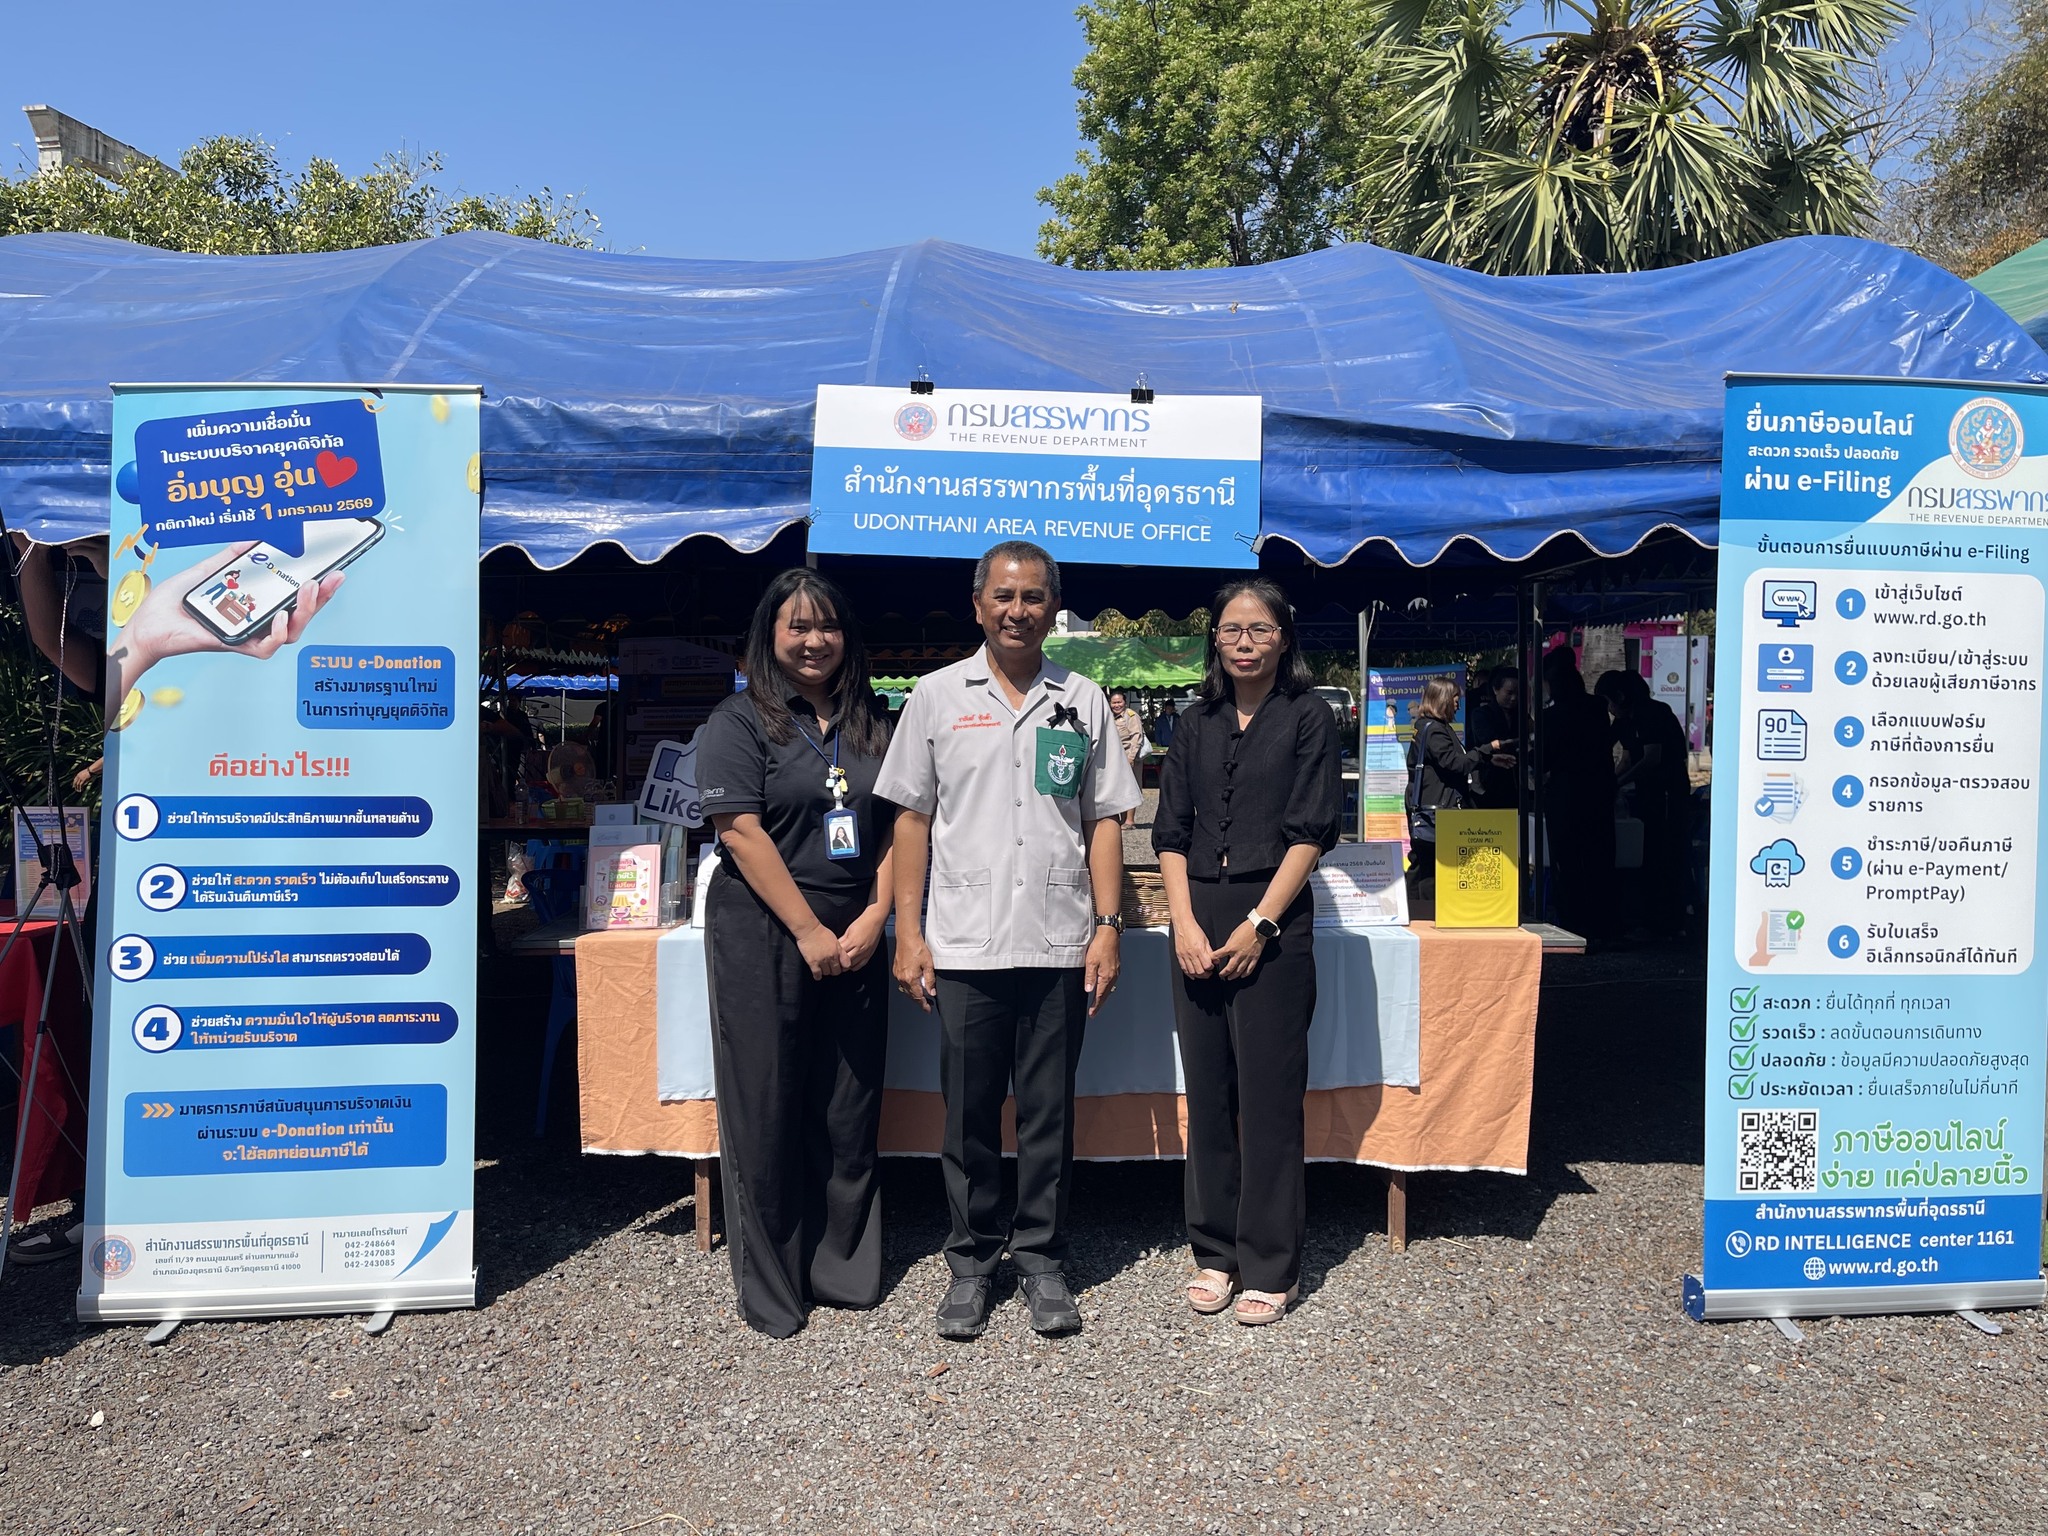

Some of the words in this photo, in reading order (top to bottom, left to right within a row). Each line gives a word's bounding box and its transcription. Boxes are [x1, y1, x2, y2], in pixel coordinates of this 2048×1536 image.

[187, 410, 312, 439] เพิ่มความเชื่อมั่น
[948, 403, 1150, 433] กรมสรรพากร
[1746, 402, 1915, 437] ยื่นภาษีออนไลน์
[161, 434, 344, 465] ในระบบบริจาคยุคดิจิทัล
[950, 432, 978, 443] THE
[982, 433, 1048, 446] REVENUE
[1053, 435, 1148, 448] DEPARTMENT
[1747, 444, 1790, 458] สะดวก
[1793, 443, 1840, 459] รวดเร็ว
[1844, 445, 1900, 461] ปลอดภัย
[167, 470, 265, 505] อิ่มบุญ
[273, 462, 317, 497] อุ่น
[844, 464, 1236, 513] สำนักงานสรรพากรพื้นที่อุดรธานี
[1744, 466, 1790, 491] ผ่าน
[1797, 470, 1892, 498] e-Filing
[1908, 486, 2048, 512] กรมสรรพาก
[155, 511, 215, 533] กติกาใหม่
[218, 508, 257, 526] เริ่มใช้
[261, 503, 273, 520] 1
[277, 504, 333, 519] มกราคม
[337, 497, 373, 512] 2569
[1909, 513, 1931, 523] THE
[1934, 514, 1984, 524] REVENUE
[1987, 515, 2048, 527] DEPARTMEN
[853, 513, 977, 534] UDONTHANI
[984, 517, 1037, 536] AREA
[1044, 520, 1135, 540] REVENUE
[1142, 523, 1212, 542] OFFICE
[1757, 534, 1963, 558] ขั้นตอนการยื่นแบบภาษีผ่าน
[1967, 544, 2030, 564] e-Filing
[1845, 598, 1854, 611] 1
[1874, 584, 1963, 605] เข้าสู่เว็บไซต์
[1874, 610, 1987, 630] www.rd.go.th
[310, 656, 353, 670] ระบบ
[358, 656, 442, 670] e-Donation
[1846, 661, 1857, 675] 2
[1872, 648, 2029, 670] ลงทะเบียน/เข้าสู่ระบบ
[314, 677, 438, 697] สร้างมาตรฐานใหม่
[1872, 673, 2037, 694] ด้วยเลขผู้เสียภาษีอากร
[303, 701, 449, 722] ในการทำบุญยุคดิจิทัล
[1871, 712, 1986, 729] เลือกแบบฟอร์ม
[1764, 717, 1787, 734] 90
[1843, 726, 1854, 739] 3
[1869, 732, 1995, 754] ภาษีที่ต้องการยื่น
[209, 751, 351, 778] ดีอย่างไร!!!
[1841, 784, 1853, 798] 4
[1869, 772, 2031, 793] กรอกข้อมูล-ตรวจสอบ
[643, 784, 702, 821] Like
[1868, 799, 1924, 813] รายการ
[124, 805, 141, 830] 1
[167, 808, 421, 827] ช่วยให้การบริจาคมีประสิทธิภาพมากขึ้นหลายด้าน
[1867, 836, 2013, 854] ชำระภาษี/ขอคืนภาษี
[1841, 857, 1852, 871] 5
[1866, 859, 1904, 878] (ผ่าน
[1908, 861, 2009, 880] e-Payment/
[150, 874, 175, 899] 2
[192, 872, 232, 887] ช่วยให้
[234, 873, 272, 886] สะดวก
[274, 871, 317, 886] รวดเร็ว
[319, 870, 450, 886] ไม่ต้องเก็บใบเสร็จกระดาษ
[193, 888, 299, 904] ได้รับเงินคืนภาษีเร็ว
[1865, 885, 1966, 904] PromptPay)
[1867, 922, 1939, 940] รับใบเสร็จ
[1838, 936, 1849, 949] 6
[119, 945, 143, 970] 3
[163, 953, 188, 965] ช่วย
[190, 949, 290, 965] เพิ่มความโปร่งใส
[292, 948, 401, 964] สามารถตรวจสอบได้
[1866, 946, 2018, 965] อิเล็กทรอนิกส์ได้ทันที
[1762, 996, 1811, 1010] สะดวก
[1825, 991, 1896, 1014] ยื่นได้ทุกที่
[1900, 996, 1951, 1014] ทุกเวลา
[142, 1016, 170, 1041] 4
[191, 1013, 243, 1028] ช่วยสร้าง
[245, 1011, 376, 1028] ความมั่นใจให้ผู้บริจาค
[378, 1011, 441, 1024] ลดภาระงาน
[190, 1029, 298, 1045] ให้หน่วยรับบริจาค
[1762, 1023, 1816, 1040] รวดเร็ว
[1830, 1022, 1982, 1041] ลดขั้นตอนการเดินทาง
[1761, 1052, 1827, 1068] ปลอดภัย
[1841, 1051, 2030, 1072] ข้อมูลมีความปลอดภัยสูงสุด
[1760, 1080, 1854, 1097] ประหยัดเวลา
[1868, 1076, 2019, 1096] ยื่นเสร็จภายในไม่กี่นาที
[179, 1095, 412, 1117] มาตรการภาษีสนับสนุนการบริจาคเงิน
[197, 1125, 259, 1142] ผ่านระบบ
[261, 1122, 345, 1138] e-Donation
[348, 1116, 394, 1135] เท่านั้น
[1833, 1117, 2008, 1153] ภาษีออนไลน์
[222, 1142, 369, 1162] จะใช้ลดหย่อนภาษีได้
[1820, 1161, 1875, 1189] ง่าย
[1885, 1153, 2029, 1189] แค่ปลายนิ้ว
[1755, 1197, 1986, 1221] สำนักงานสรรพากรพื้นที่อุดรธานี
[145, 1232, 310, 1252] สำนักงานสรรพากรพื้นที่อุดรธานี
[332, 1226, 409, 1239] หมายเลขโทรศัพท์
[1754, 1236, 1780, 1251] RD
[1784, 1233, 1912, 1250] INTELLIGENCE
[1919, 1232, 1974, 1247] center
[1977, 1230, 2015, 1246] 1161
[344, 1239, 396, 1250] 042-248664
[344, 1249, 396, 1259] 042-247083
[344, 1259, 396, 1270] 042-243085
[1829, 1257, 1939, 1277] www.rd.go.th
